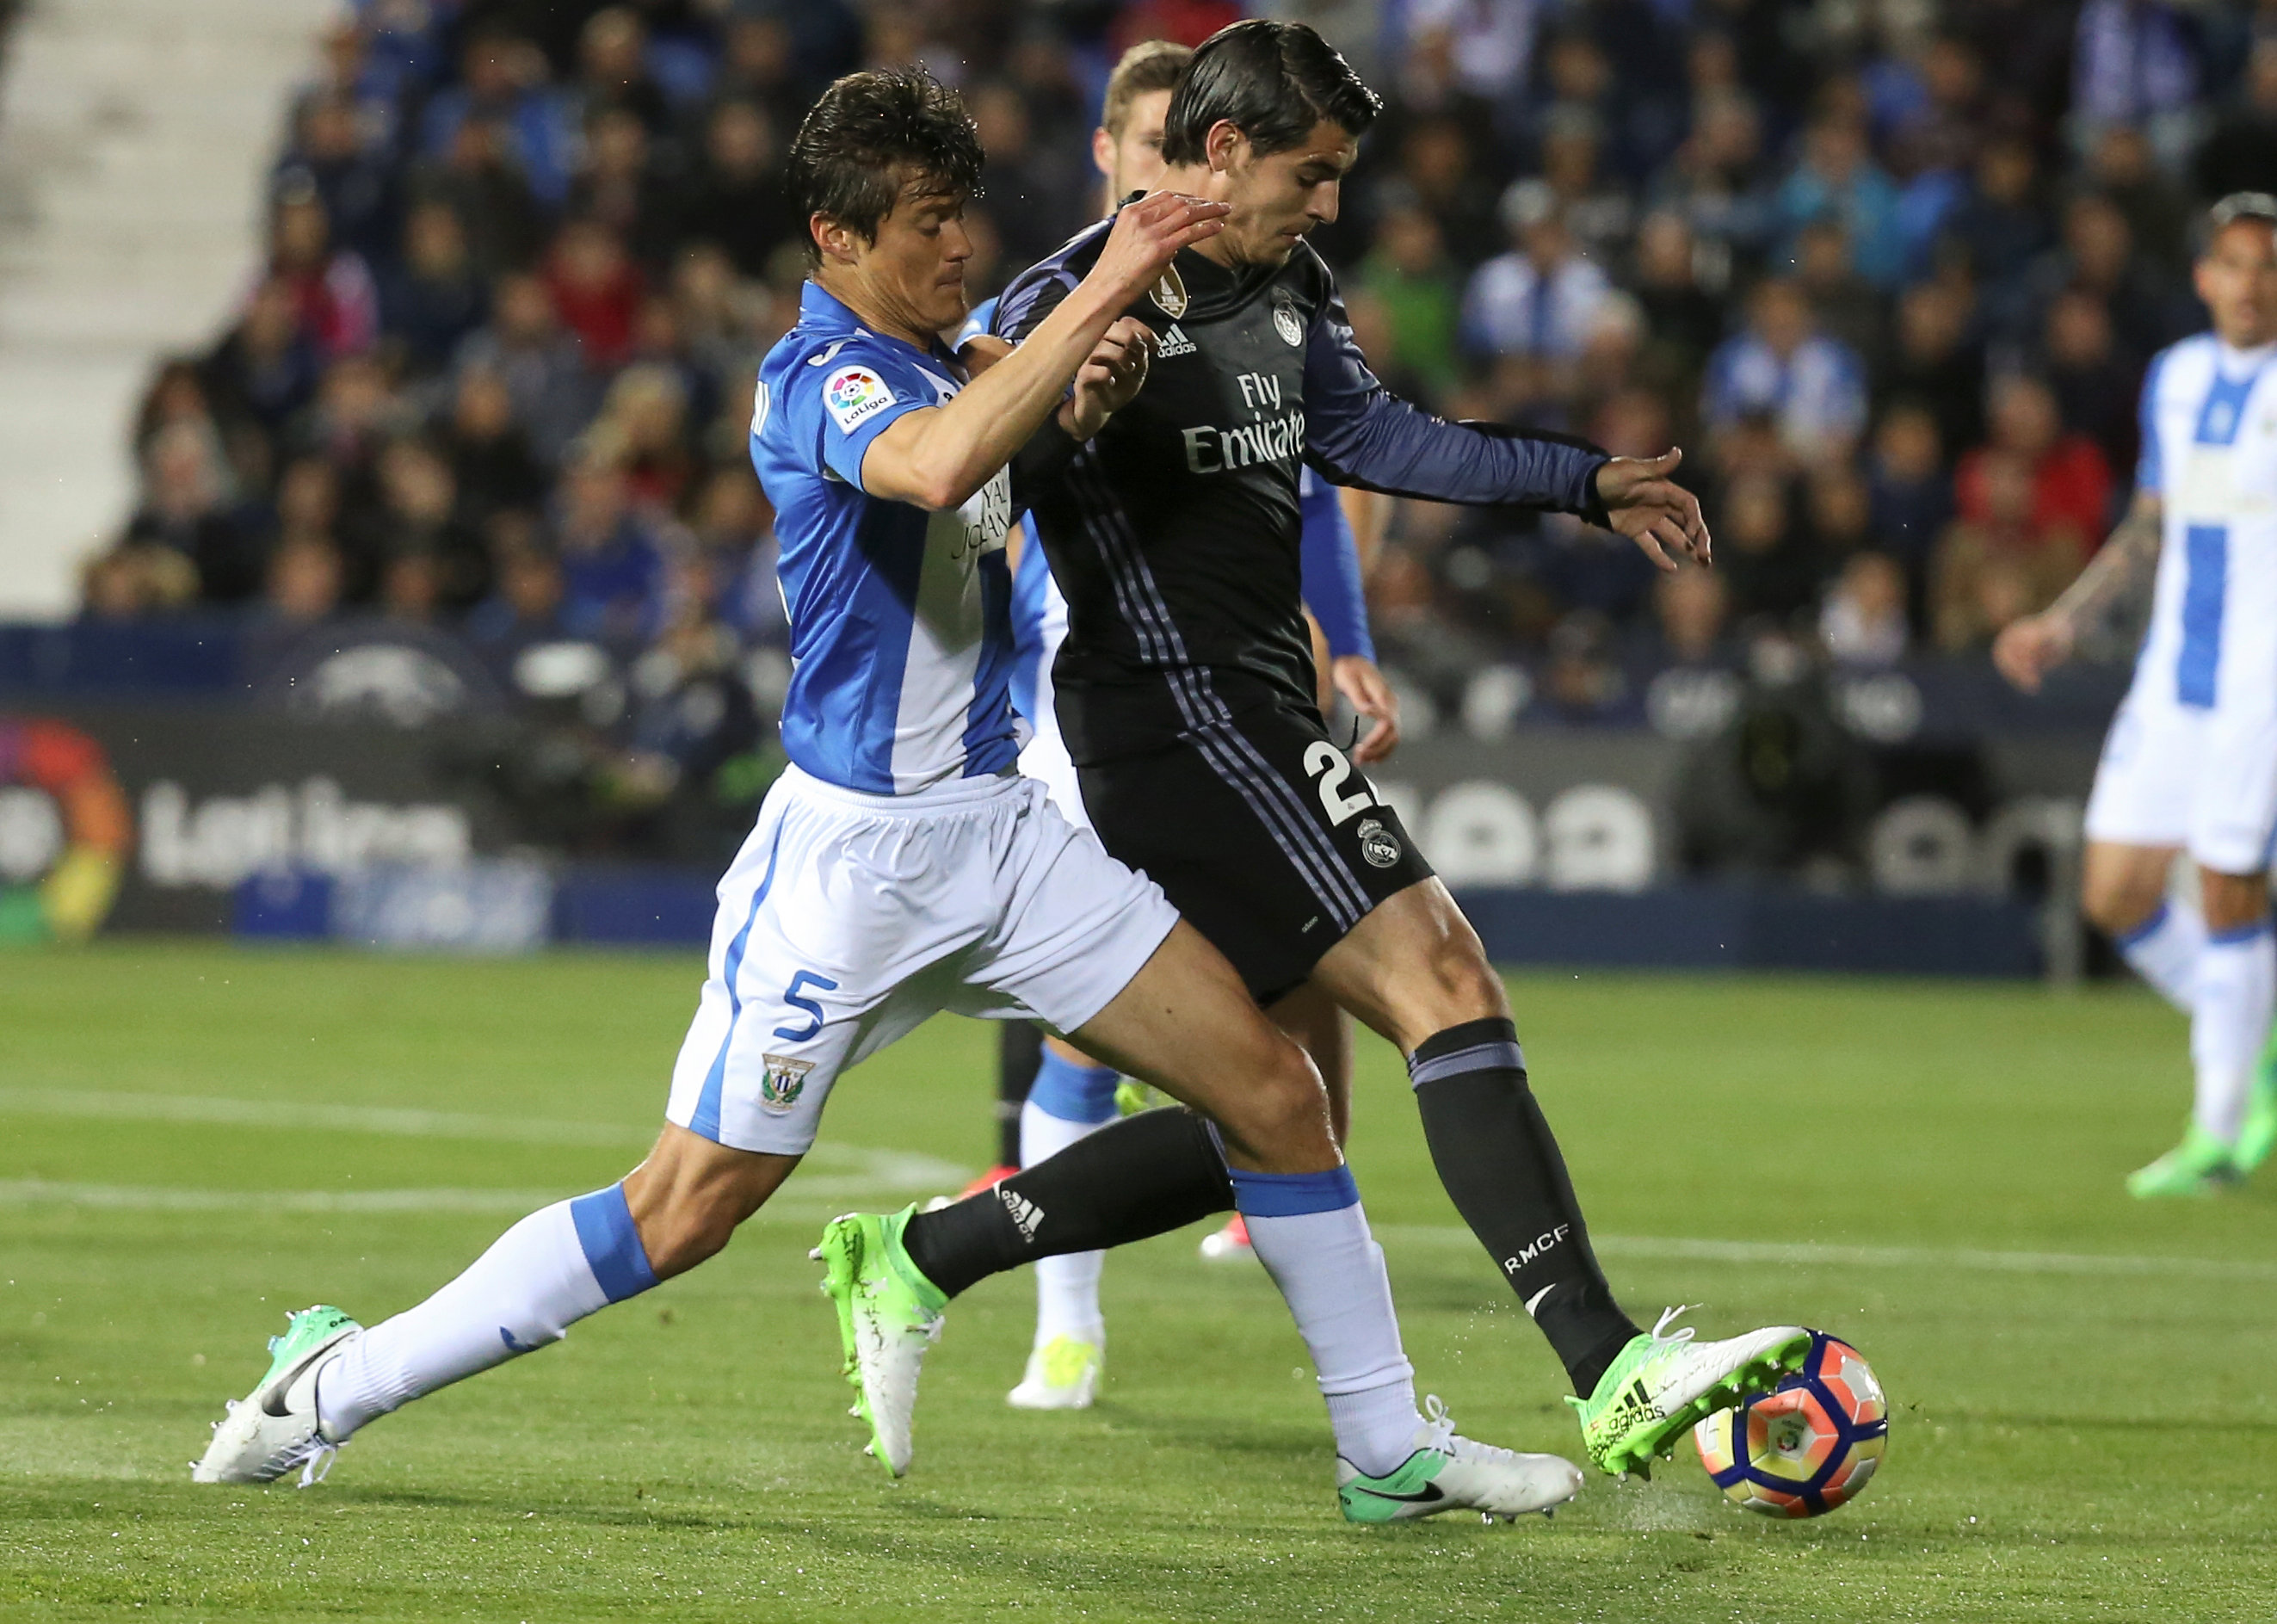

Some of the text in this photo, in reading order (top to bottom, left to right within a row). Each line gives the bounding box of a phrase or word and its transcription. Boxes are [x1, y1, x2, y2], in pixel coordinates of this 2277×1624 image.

[1157, 343, 1197, 358] adidas
[843, 396, 888, 425] LaLiga
[1237, 372, 1280, 410] Fly
[1181, 407, 1305, 473] Emirate
[1303, 740, 1382, 827] 2
[773, 969, 838, 1043] 5
[1001, 1189, 1035, 1244] adidas
[1504, 1223, 1569, 1275] RMCF
[1608, 1404, 1668, 1430] adidas
